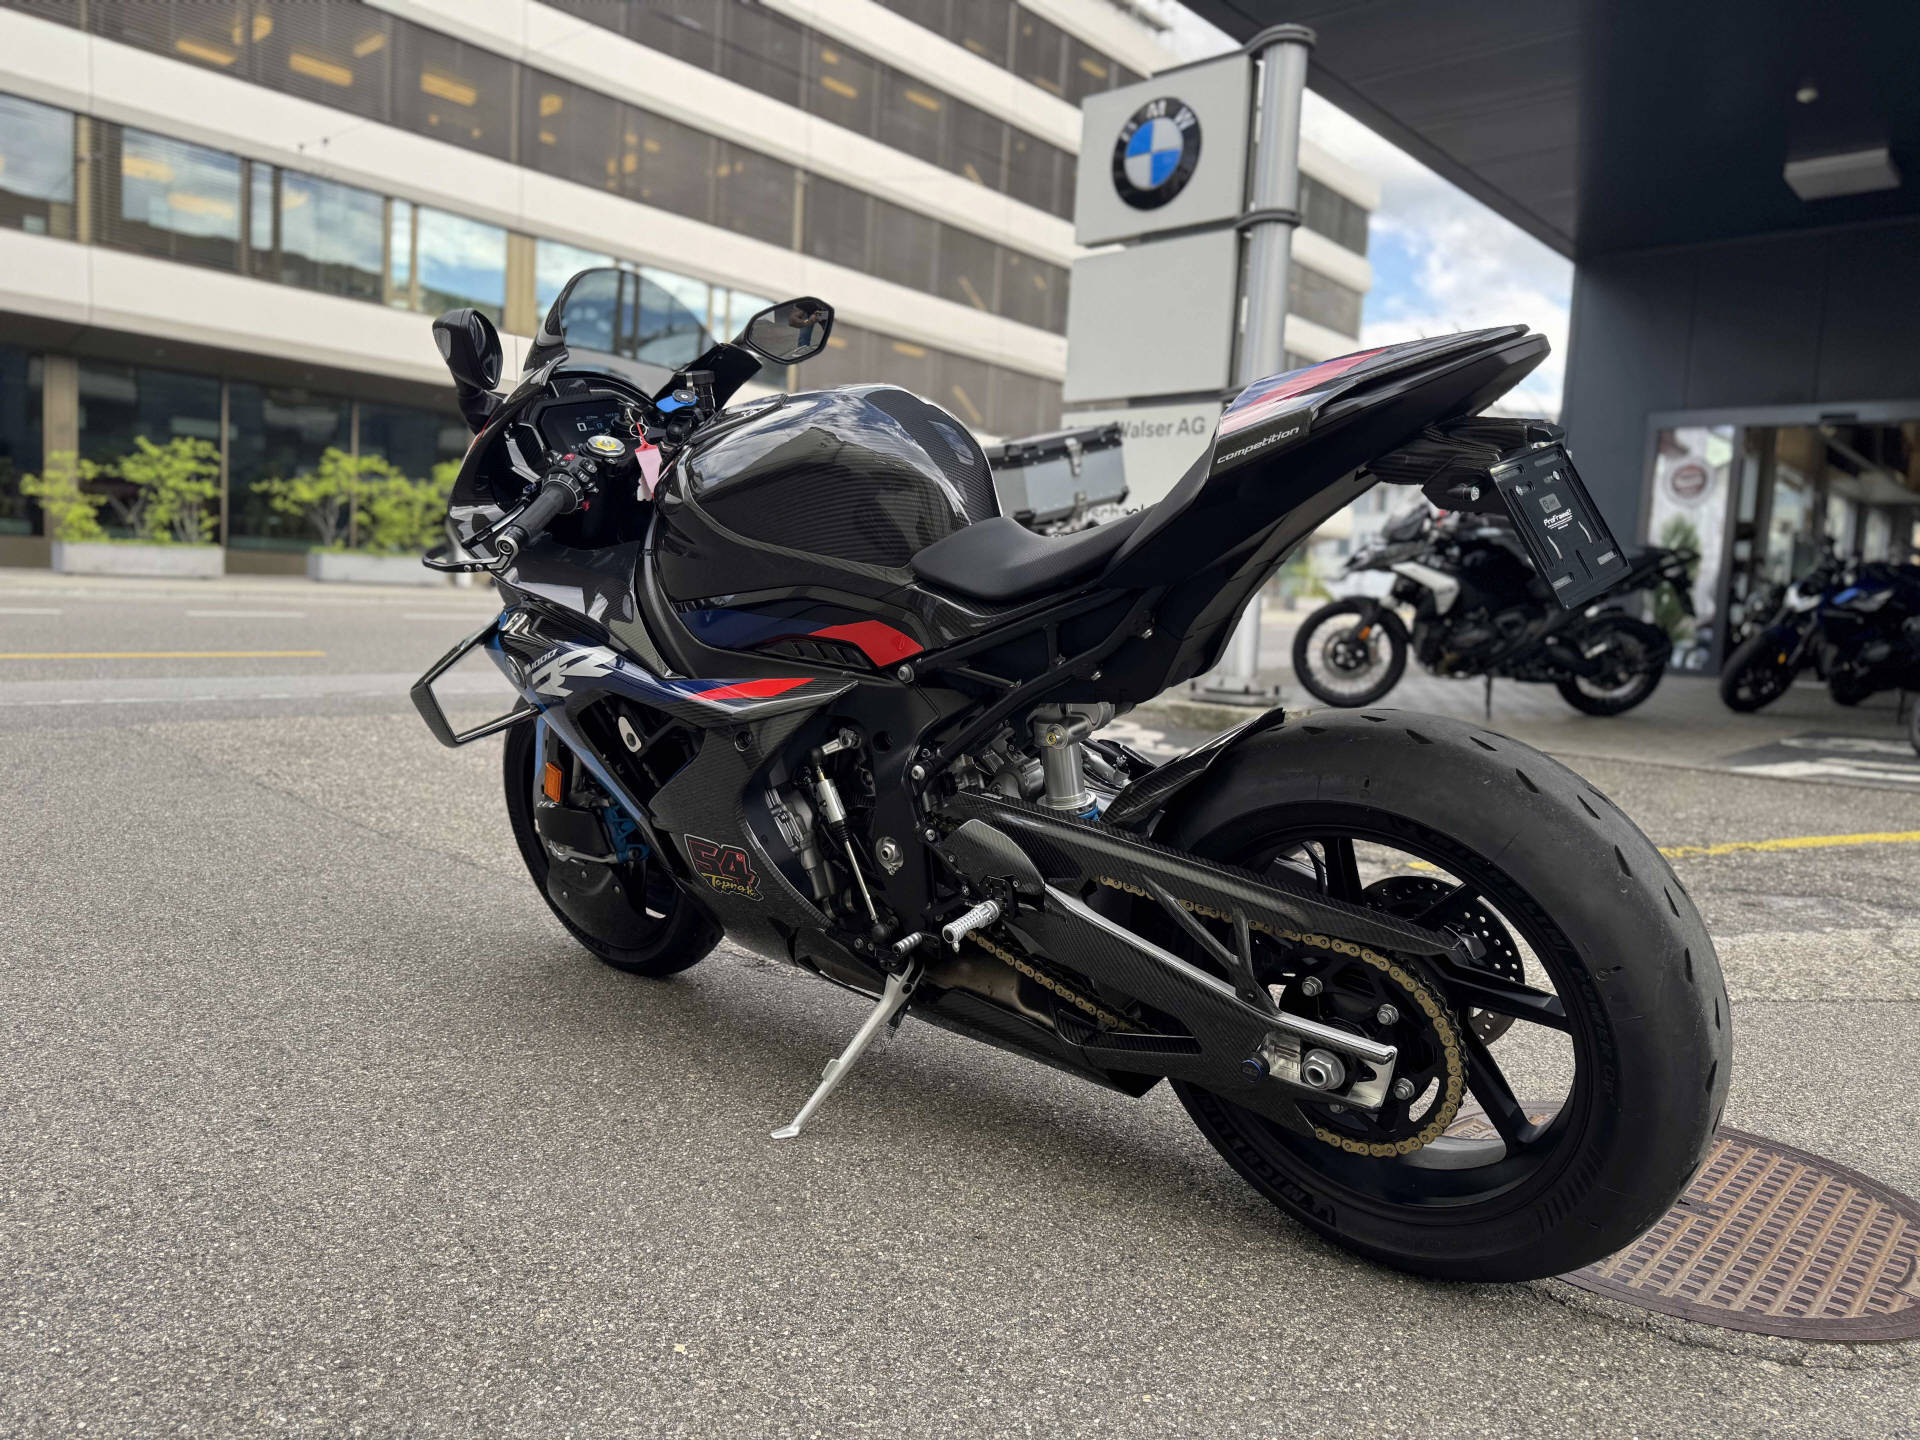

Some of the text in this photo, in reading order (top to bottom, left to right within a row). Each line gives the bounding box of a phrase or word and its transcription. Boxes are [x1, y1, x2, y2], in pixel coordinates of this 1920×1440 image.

[1120, 99, 1196, 142] BMW
[1176, 416, 1206, 436] AG
[1216, 426, 1300, 464] competition
[532, 646, 619, 697] RR
[688, 840, 756, 886] 54
